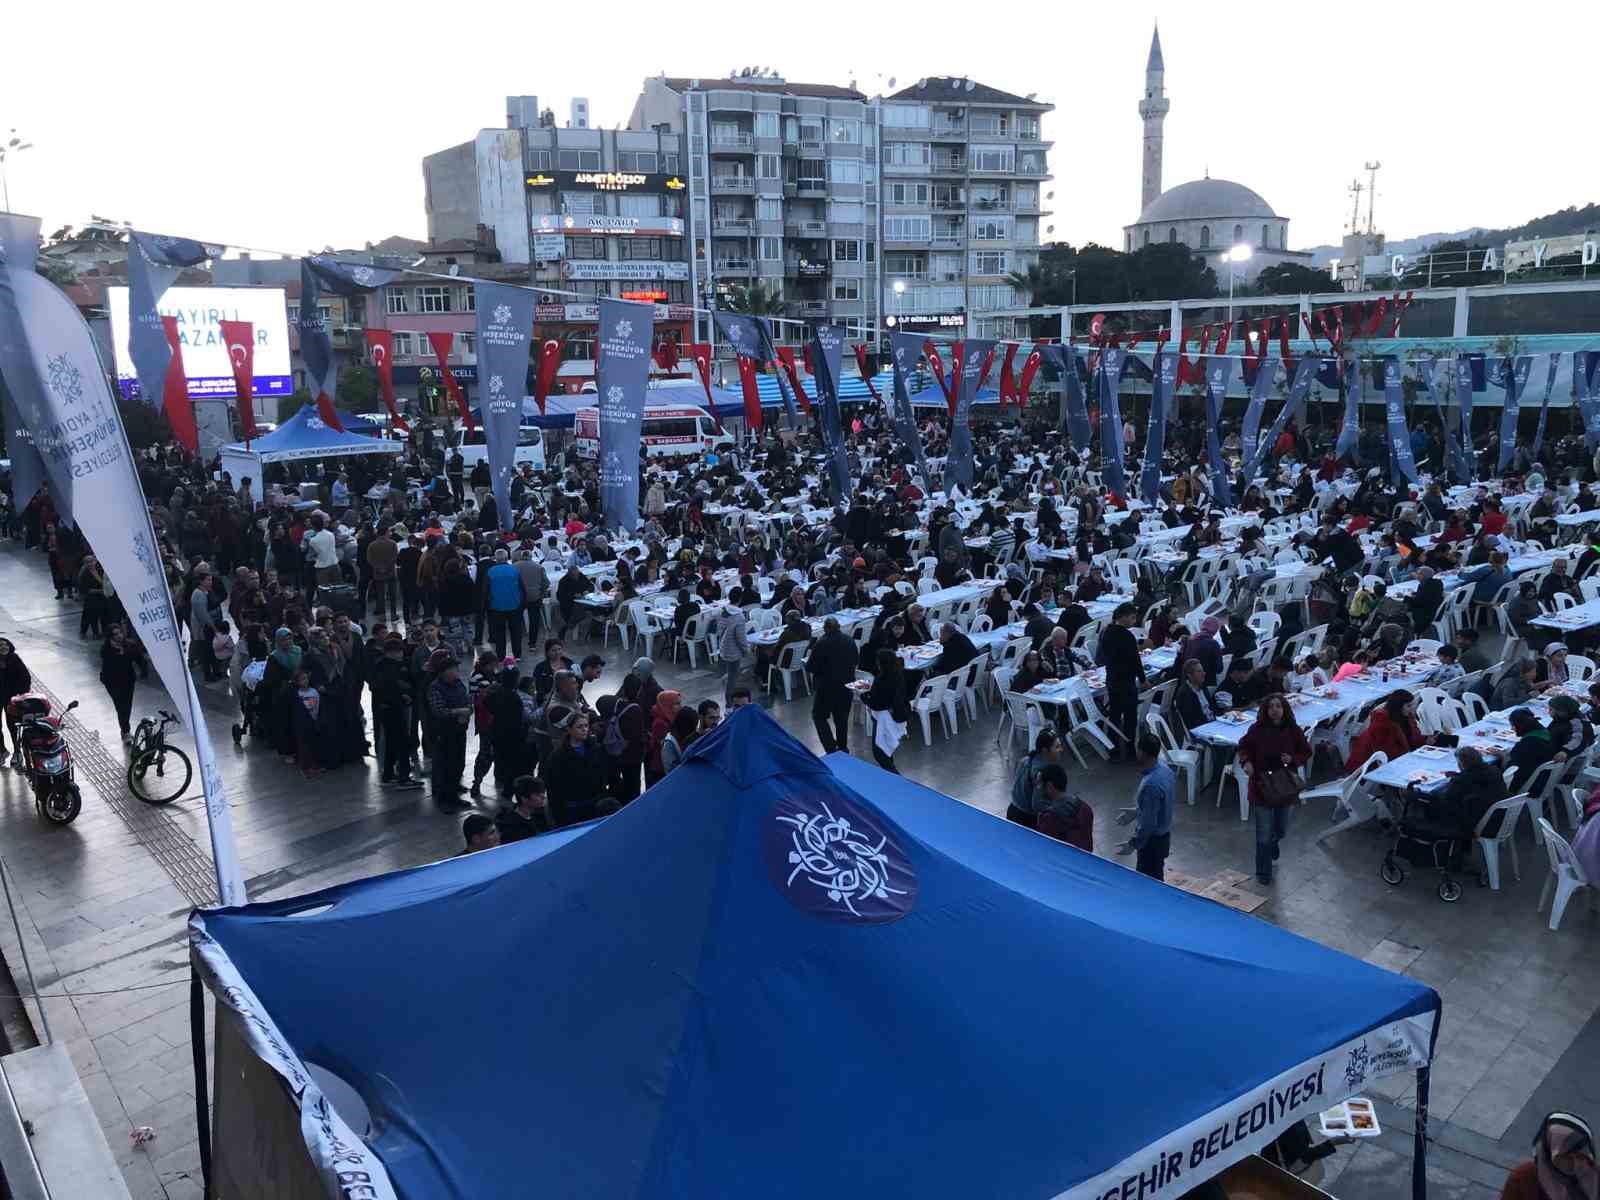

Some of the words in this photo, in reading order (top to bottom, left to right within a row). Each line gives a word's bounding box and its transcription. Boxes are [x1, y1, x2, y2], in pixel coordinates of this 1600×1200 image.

[575, 173, 606, 184] AHMET
[588, 217, 603, 226] AK
[435, 368, 474, 377] TUKCELL
[1189, 1062, 1326, 1170] BELEDİYESİ
